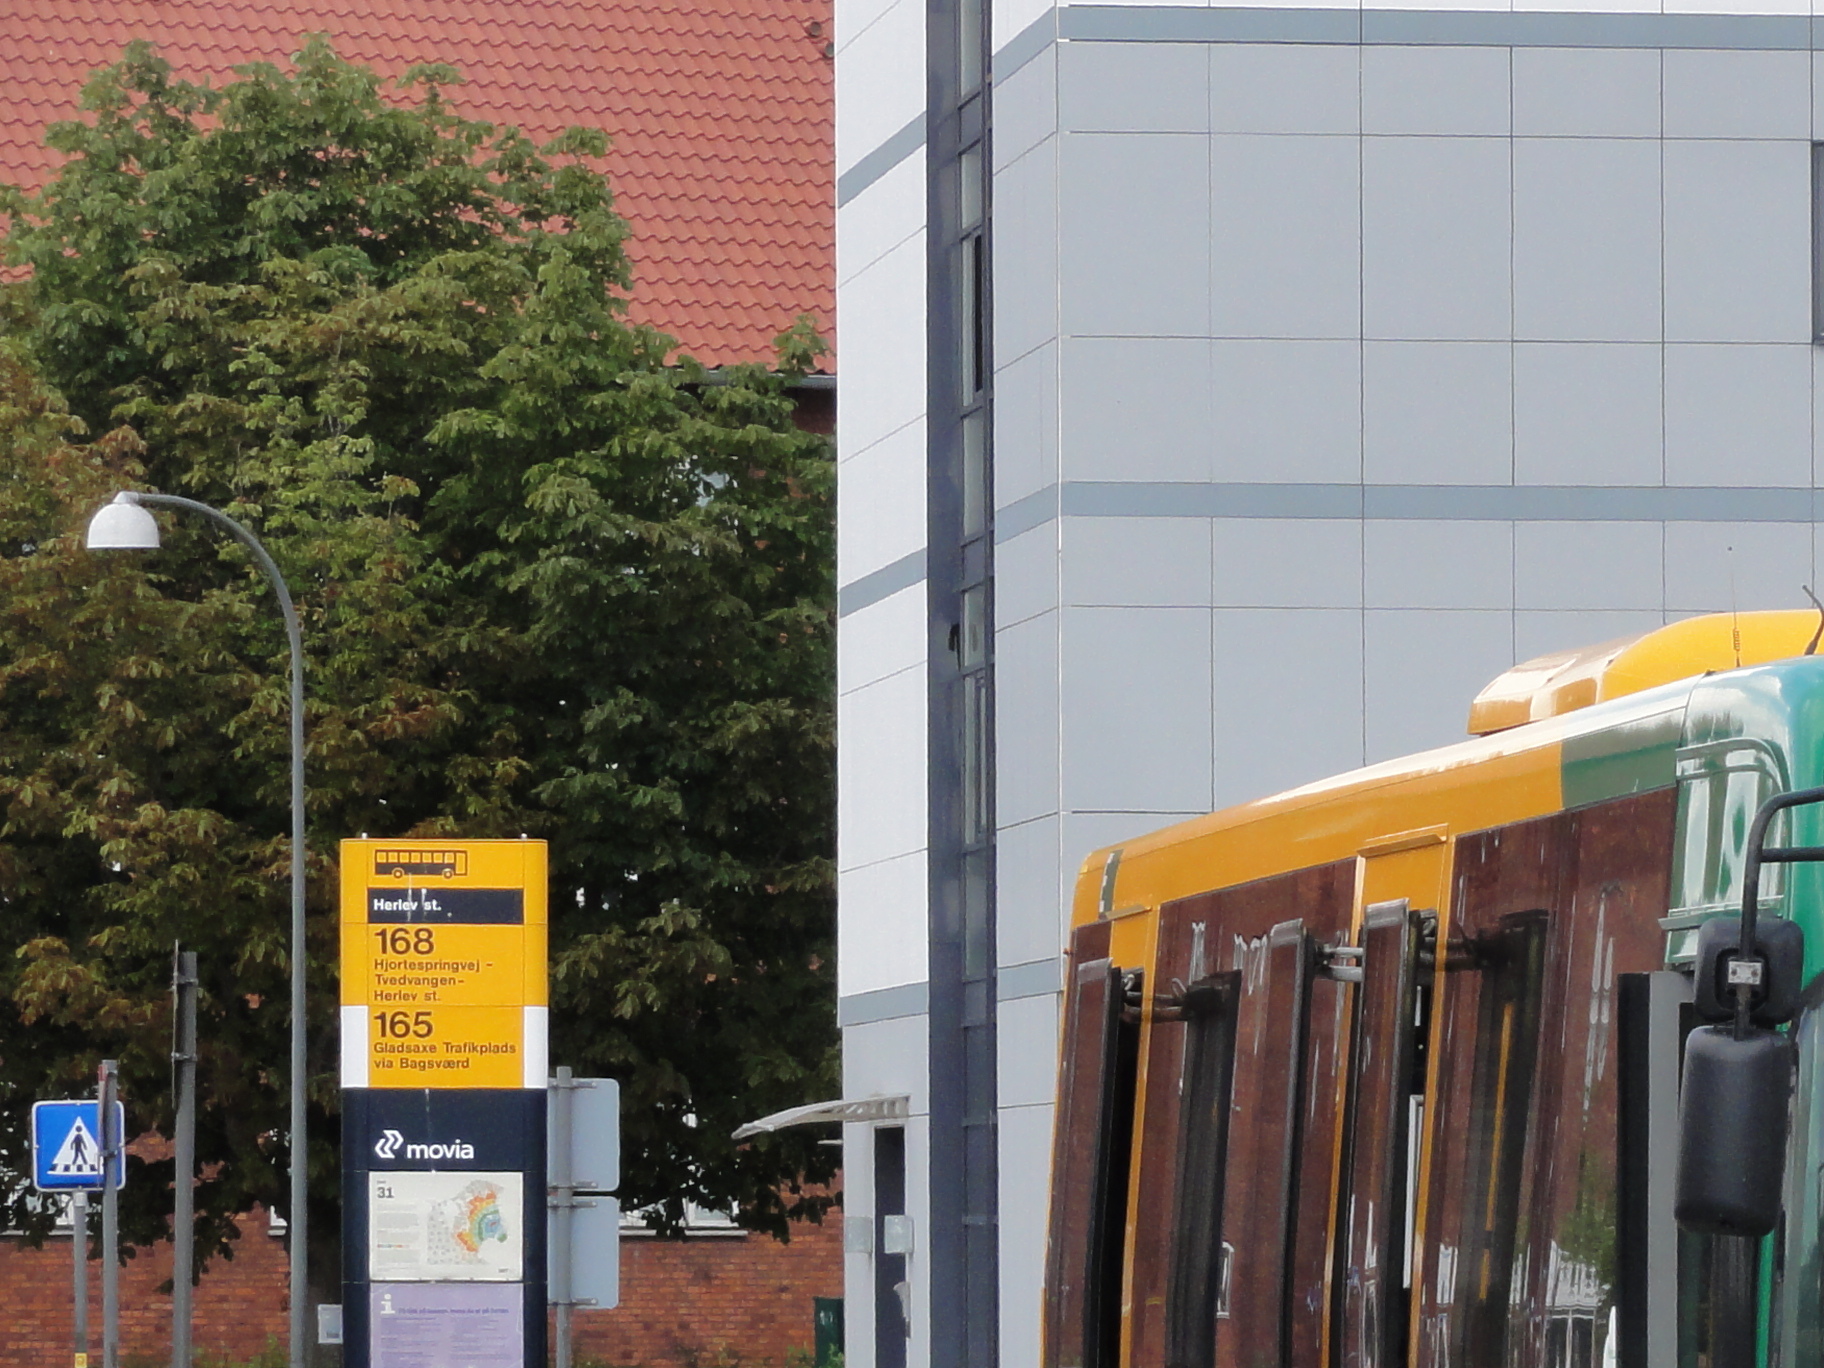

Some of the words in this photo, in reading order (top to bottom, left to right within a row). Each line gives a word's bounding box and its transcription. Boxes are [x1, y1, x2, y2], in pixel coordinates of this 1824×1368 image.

[373, 898, 418, 911] Herlev
[424, 899, 442, 911] st.
[374, 927, 434, 955] 168
[374, 958, 480, 973] Hjortespringvej
[374, 990, 418, 1001] Herlev
[424, 990, 441, 1001] st.
[374, 1011, 433, 1038] 165
[373, 1042, 437, 1054] Gladsaxe
[442, 1042, 516, 1056] Trafikplads
[374, 1058, 394, 1069] via
[399, 1058, 470, 1071] Bagsværd
[406, 1139, 474, 1160] movia
[377, 1186, 394, 1199] 31
